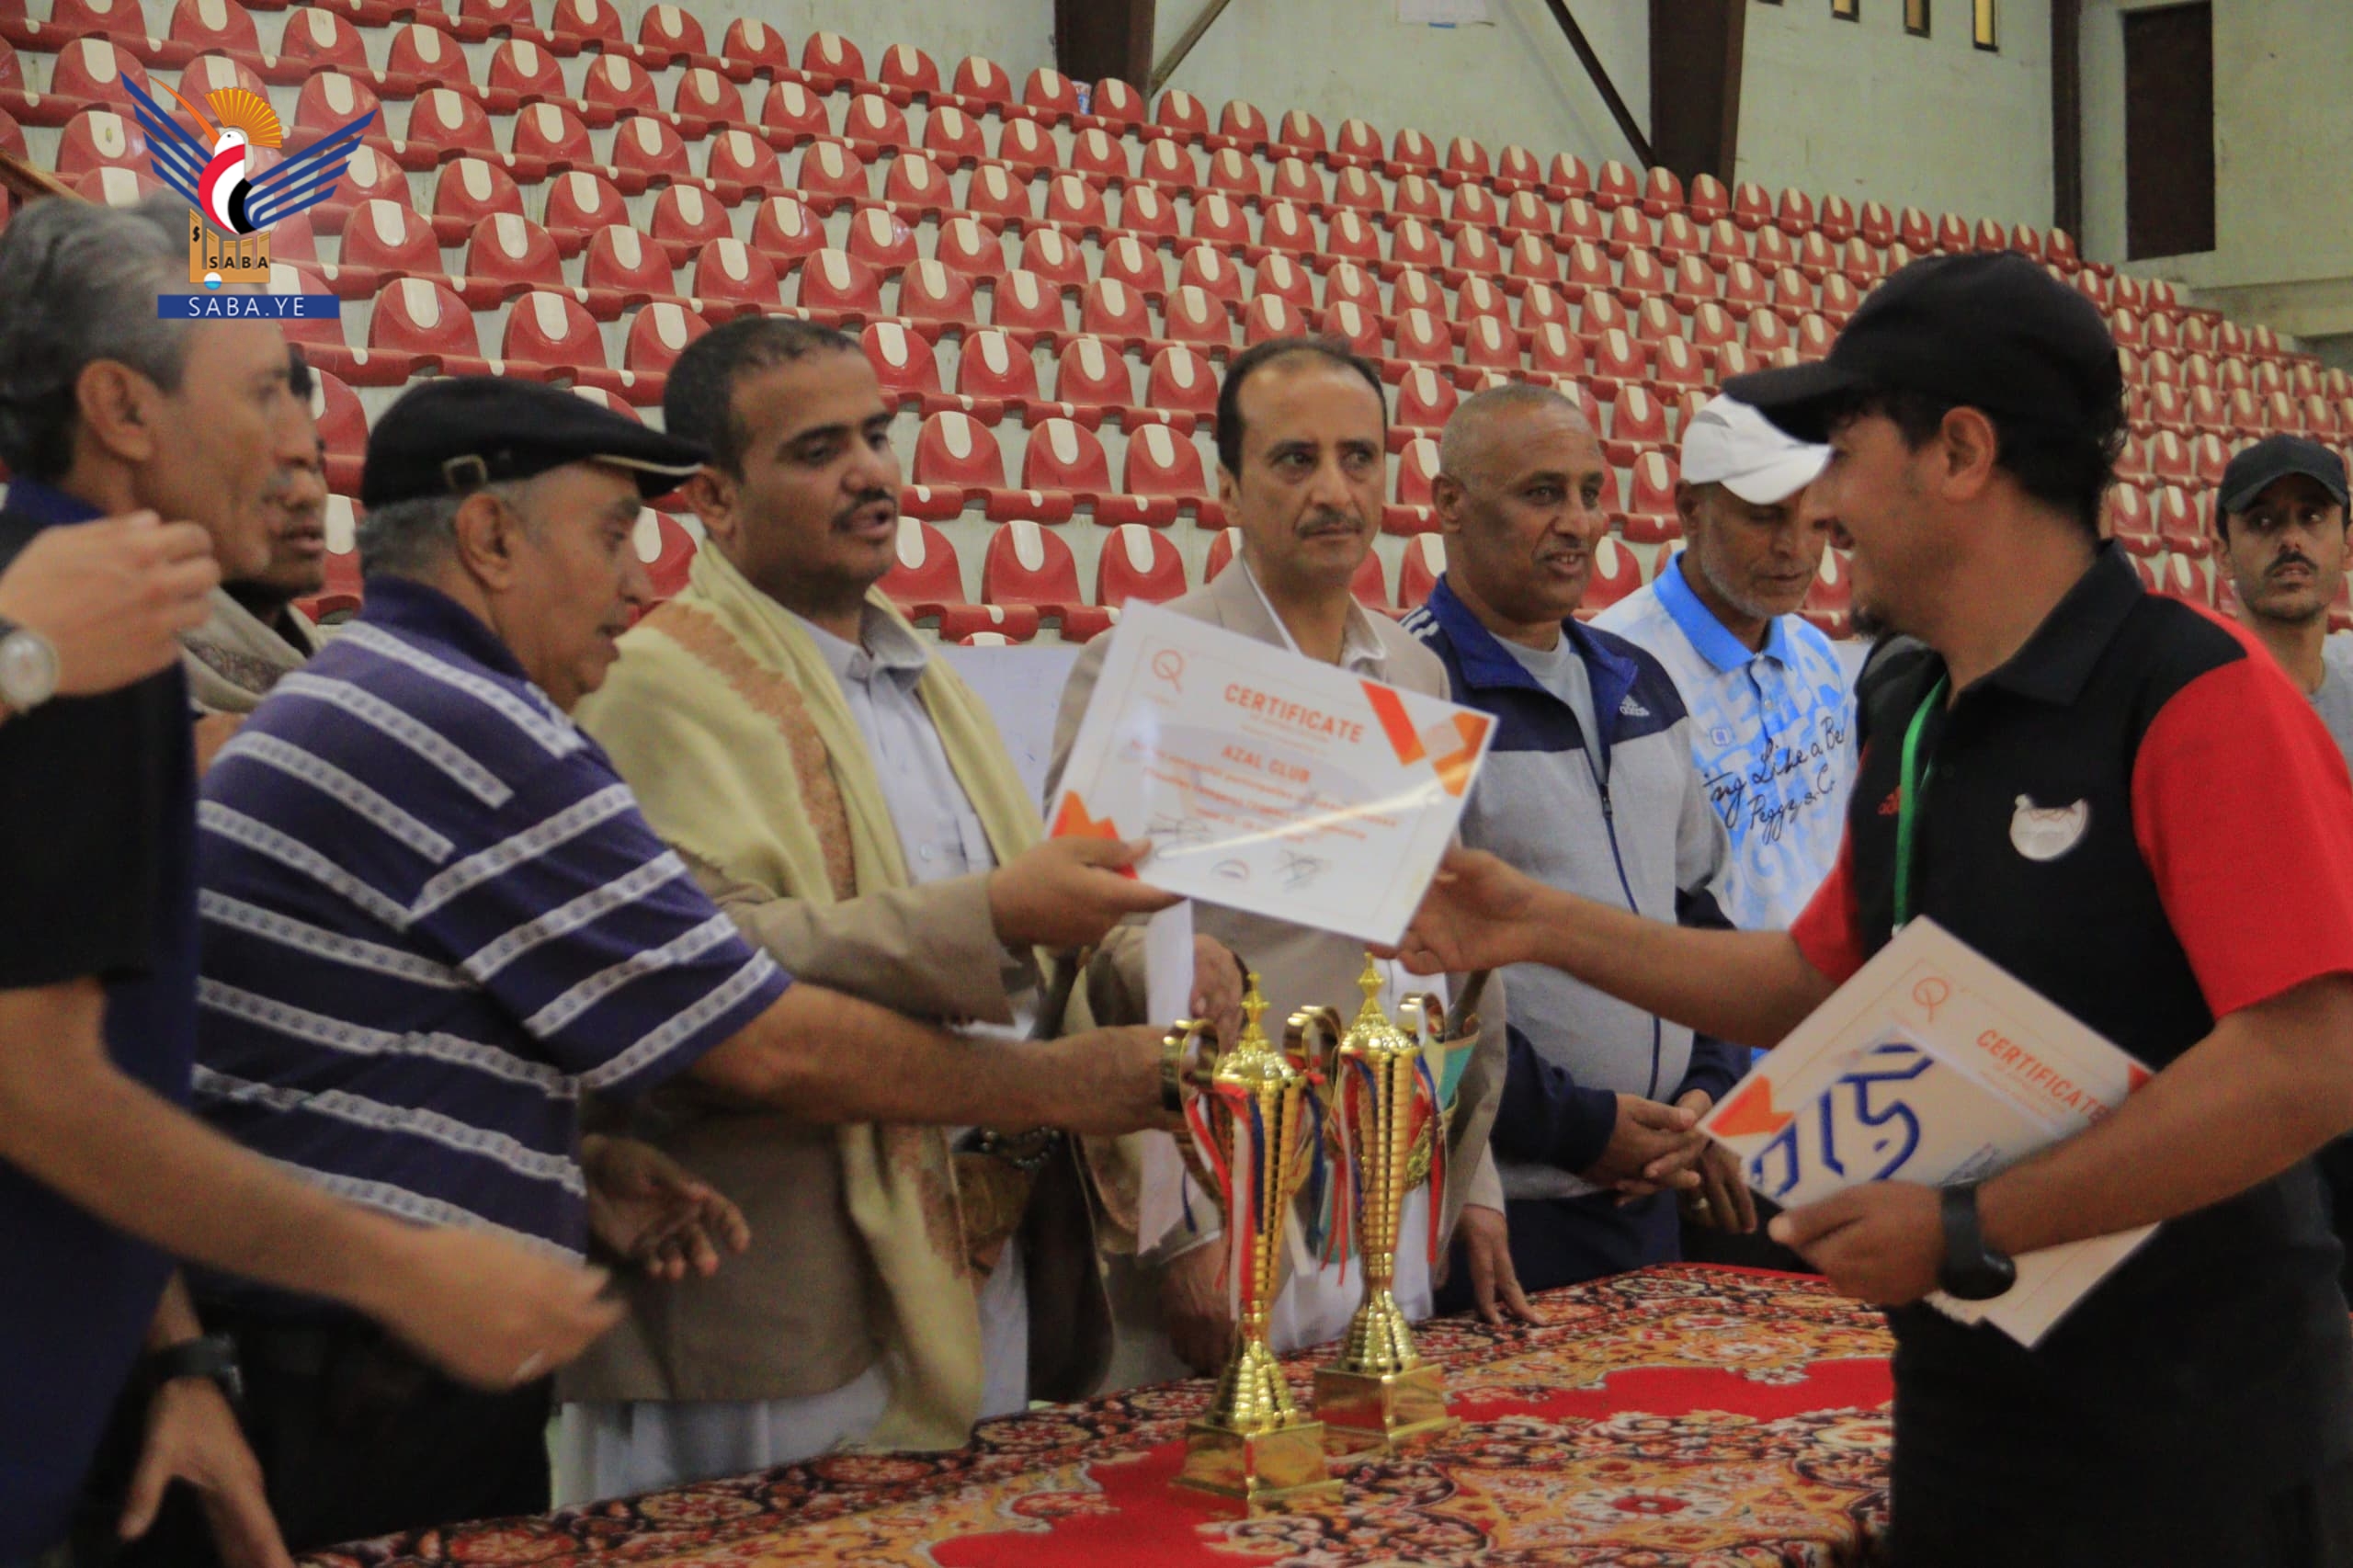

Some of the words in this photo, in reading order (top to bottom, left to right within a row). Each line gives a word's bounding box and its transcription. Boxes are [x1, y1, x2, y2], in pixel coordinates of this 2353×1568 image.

[1224, 683, 1364, 744] CERTIFICATE
[1222, 744, 1267, 770] AZAL
[1751, 737, 1809, 784] Like
